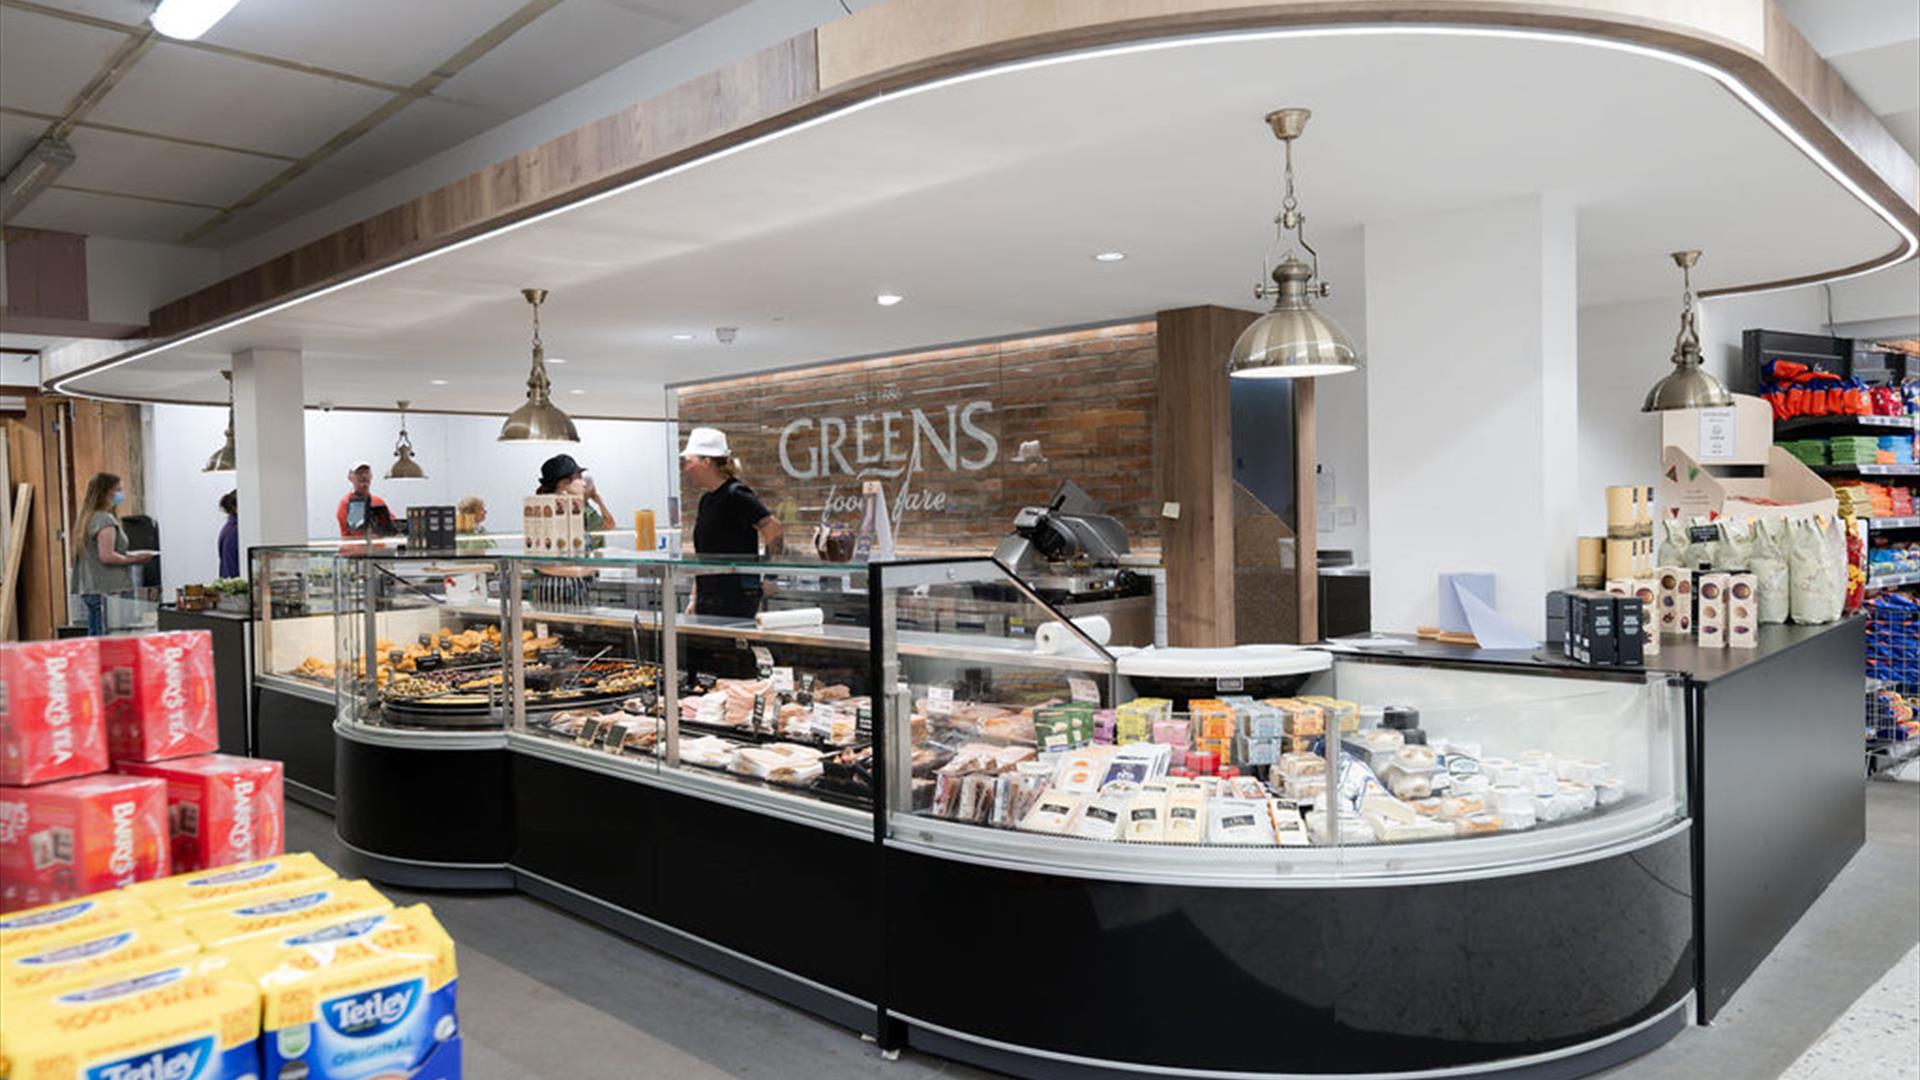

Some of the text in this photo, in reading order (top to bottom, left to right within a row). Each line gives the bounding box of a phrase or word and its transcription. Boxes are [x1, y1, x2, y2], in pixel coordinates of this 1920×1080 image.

[778, 400, 999, 480] GREENS
[892, 480, 947, 522] fare
[52, 729, 73, 765] TEA
[168, 709, 187, 746] TEA
[331, 988, 414, 1029] Tetley
